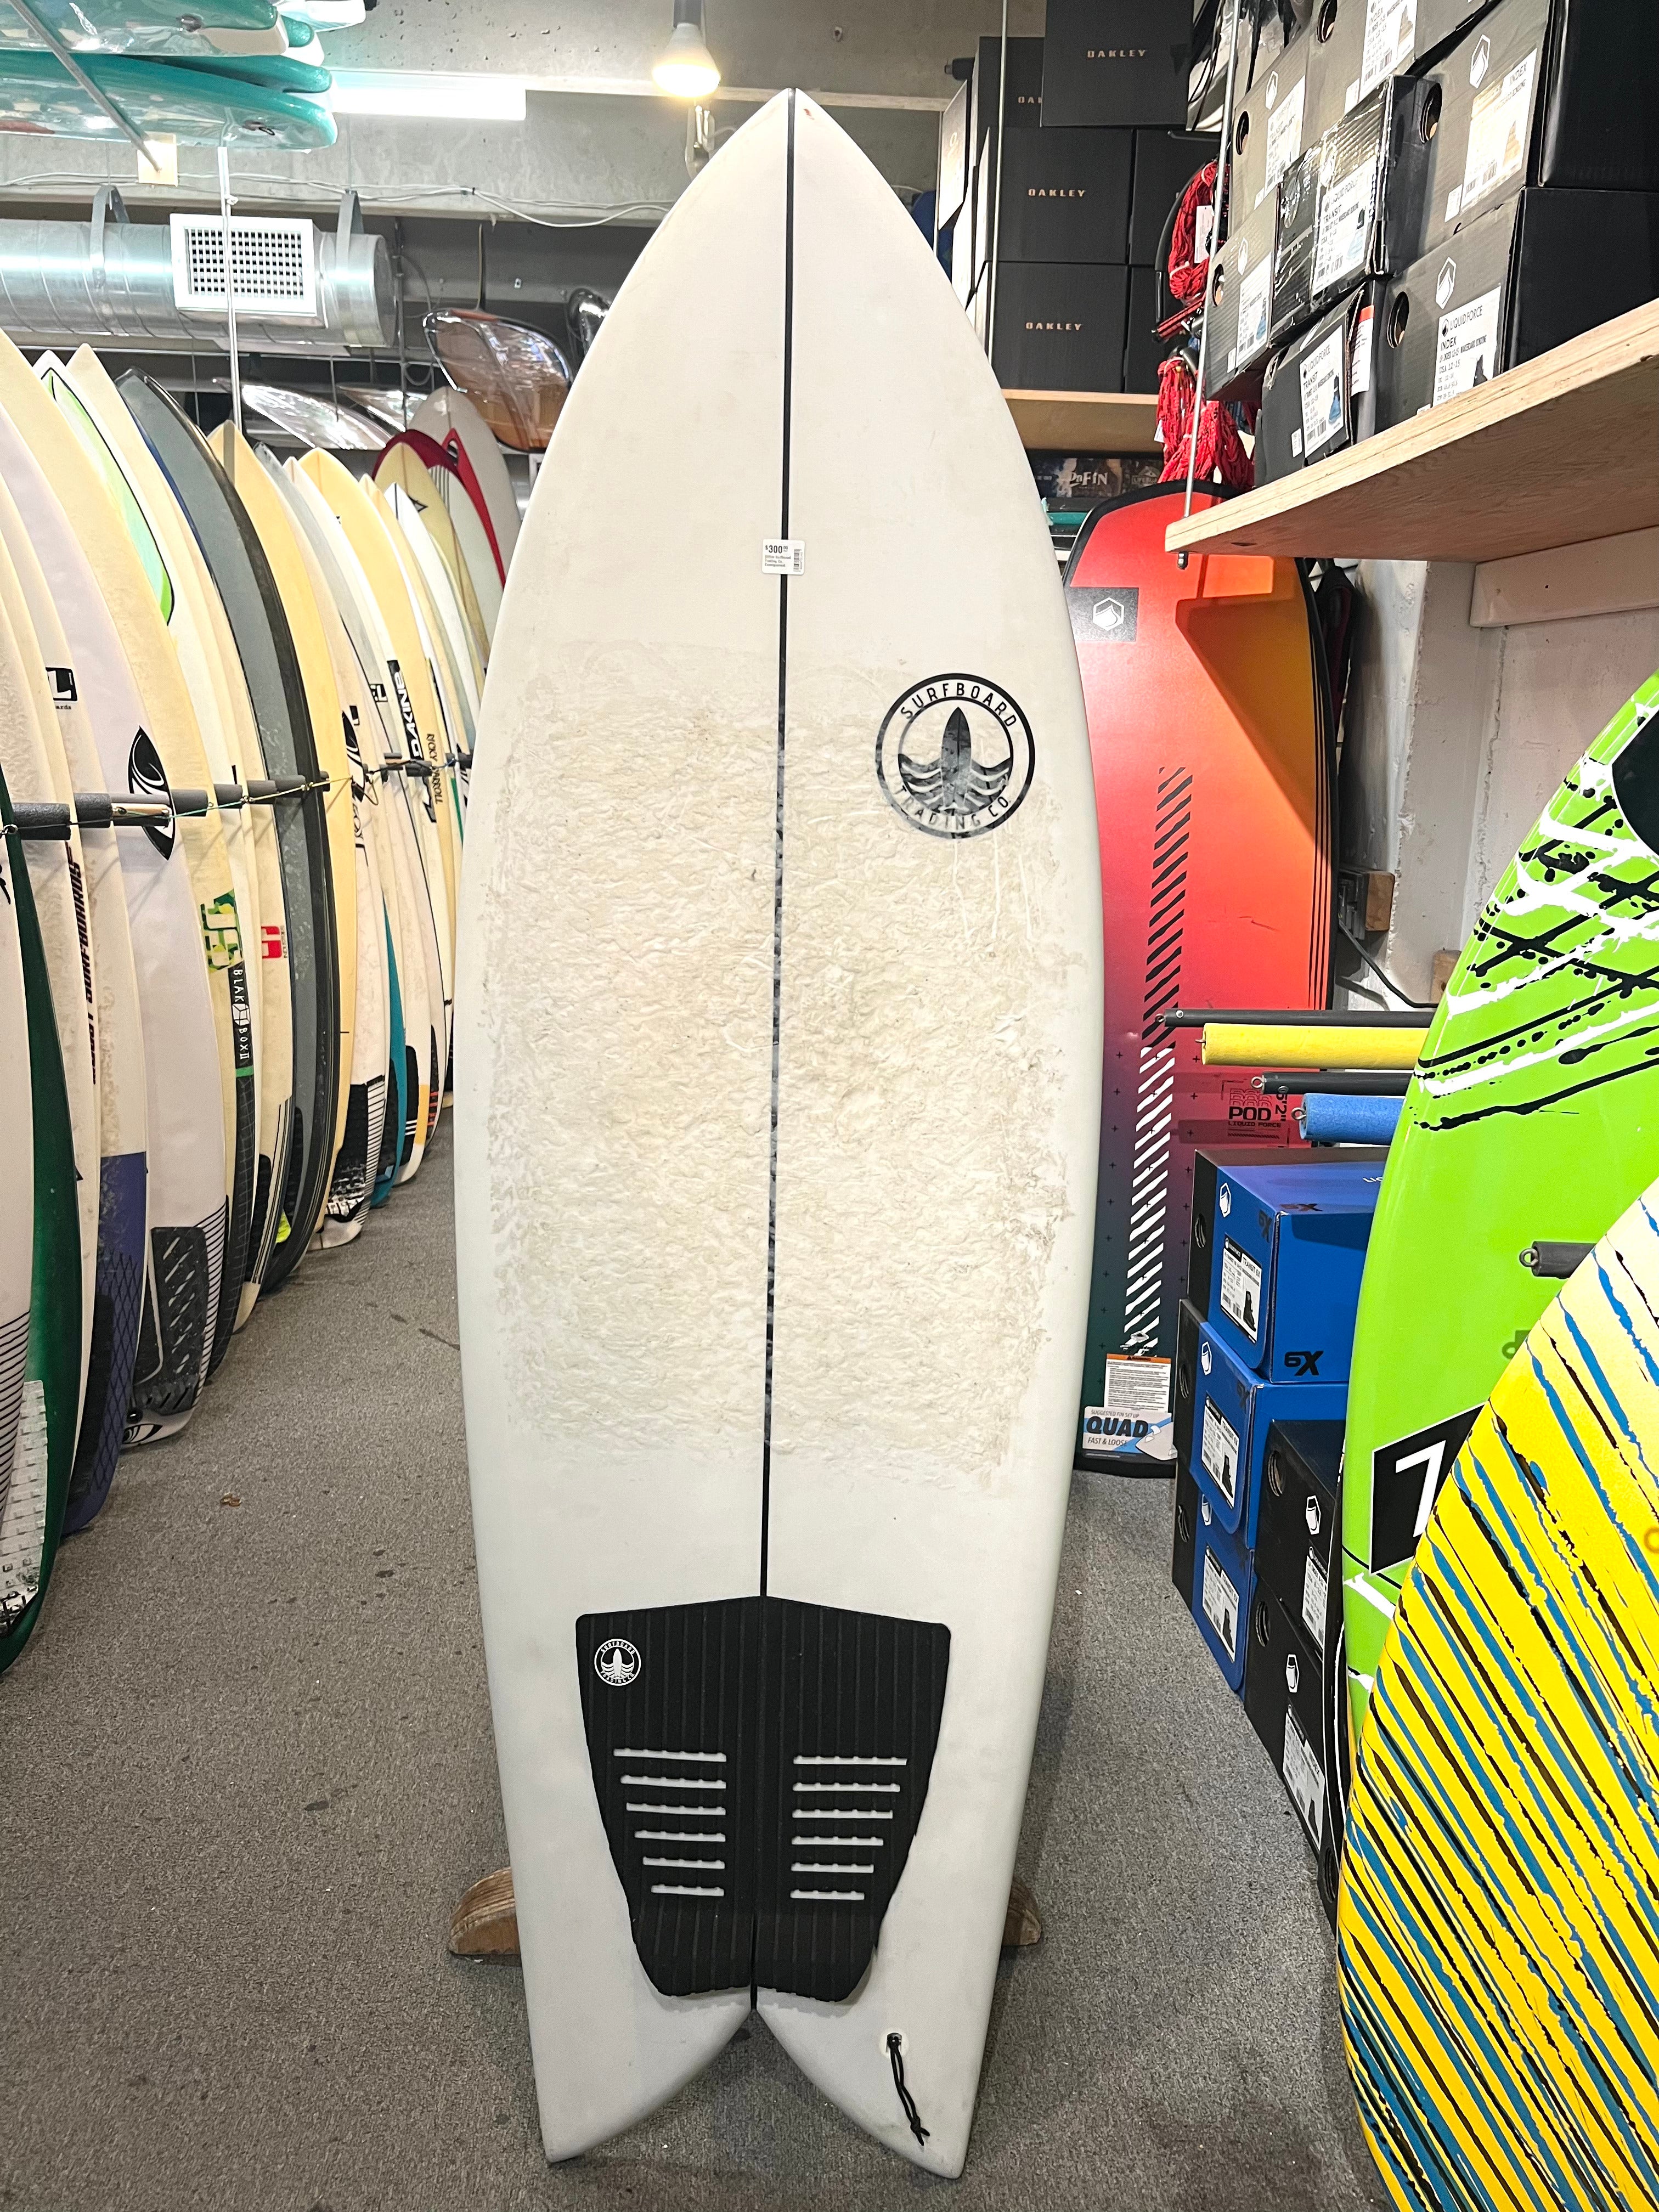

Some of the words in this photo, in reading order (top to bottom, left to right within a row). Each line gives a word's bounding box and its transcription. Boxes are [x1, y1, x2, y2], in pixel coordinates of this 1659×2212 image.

[1087, 49, 1146, 58] OAKLEY
[1509, 62, 1527, 86] INDEX
[1028, 189, 1086, 197] OAKLEY
[1026, 322, 1082, 330] OAKLEY
[1450, 313, 1466, 330] LIQUID
[1466, 306, 1483, 323] FORCE
[1441, 336, 1457, 352] INDEX
[1304, 371, 1318, 391] TRANSIT
[394, 672, 424, 759] DAKINE
[900, 682, 1018, 728] SURFBOARD
[431, 766, 443, 805] ARROLL
[233, 969, 244, 1002] BLAK
[1229, 1106, 1272, 1120] POD
[1284, 1350, 1324, 1376] 6X
[1086, 1416, 1149, 1438] QUAD
[600, 1641, 635, 1655] SURFBOARD
